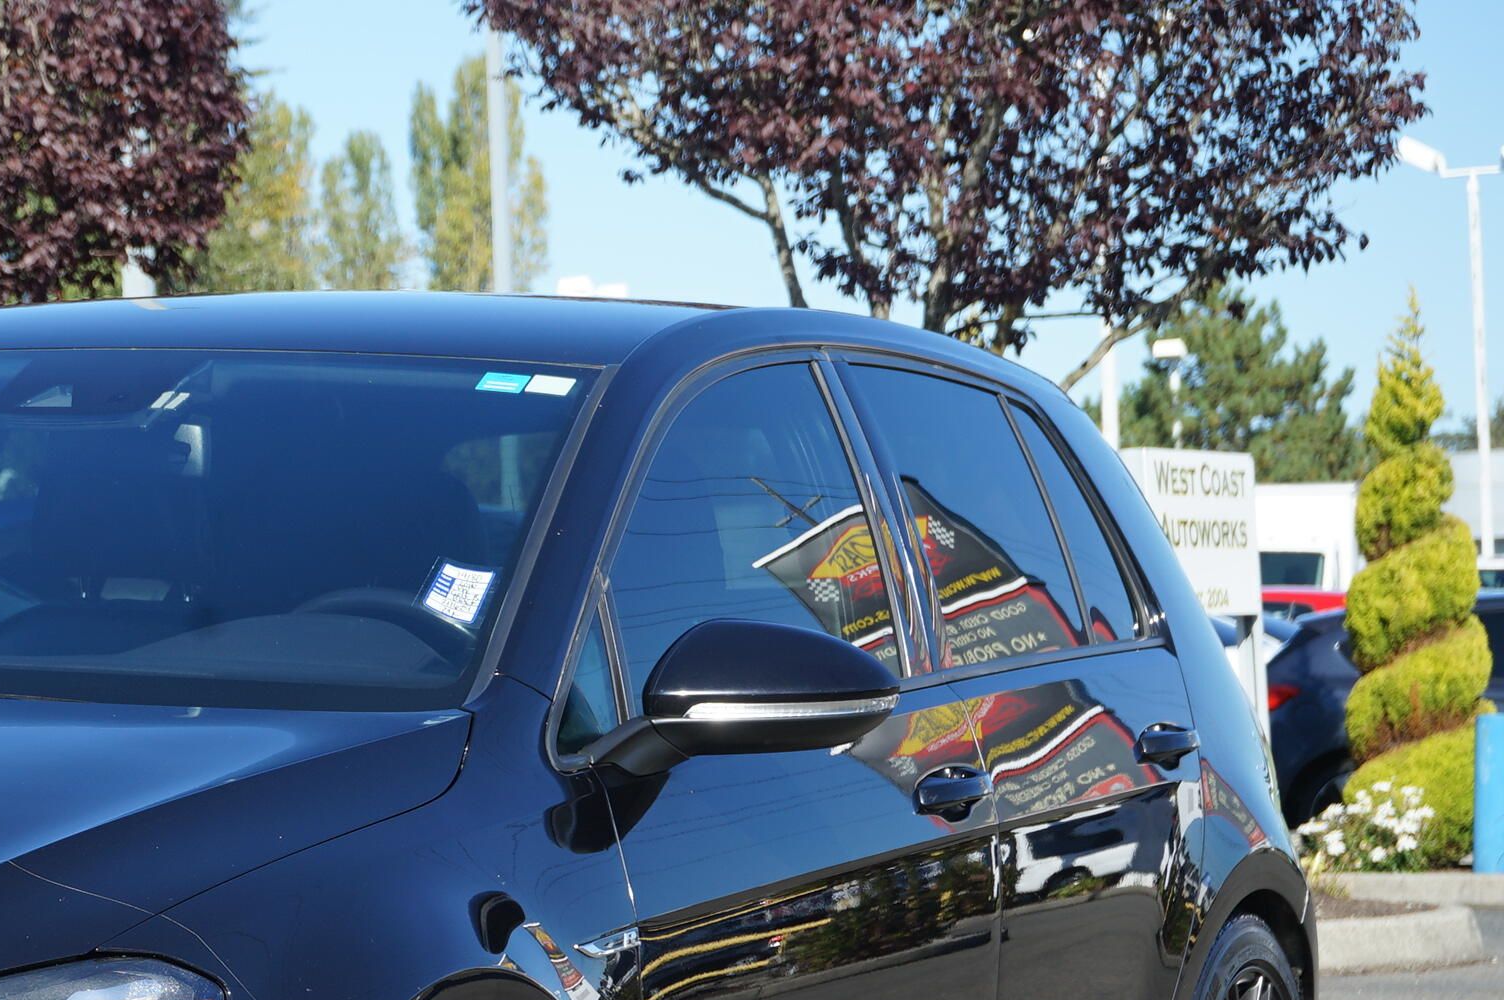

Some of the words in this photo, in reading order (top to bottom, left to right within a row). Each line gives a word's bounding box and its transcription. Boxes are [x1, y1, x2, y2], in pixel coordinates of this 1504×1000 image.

[1154, 459, 1196, 496] WEST
[1200, 462, 1246, 497] COAST
[1161, 512, 1248, 548] AUTOWORKS
